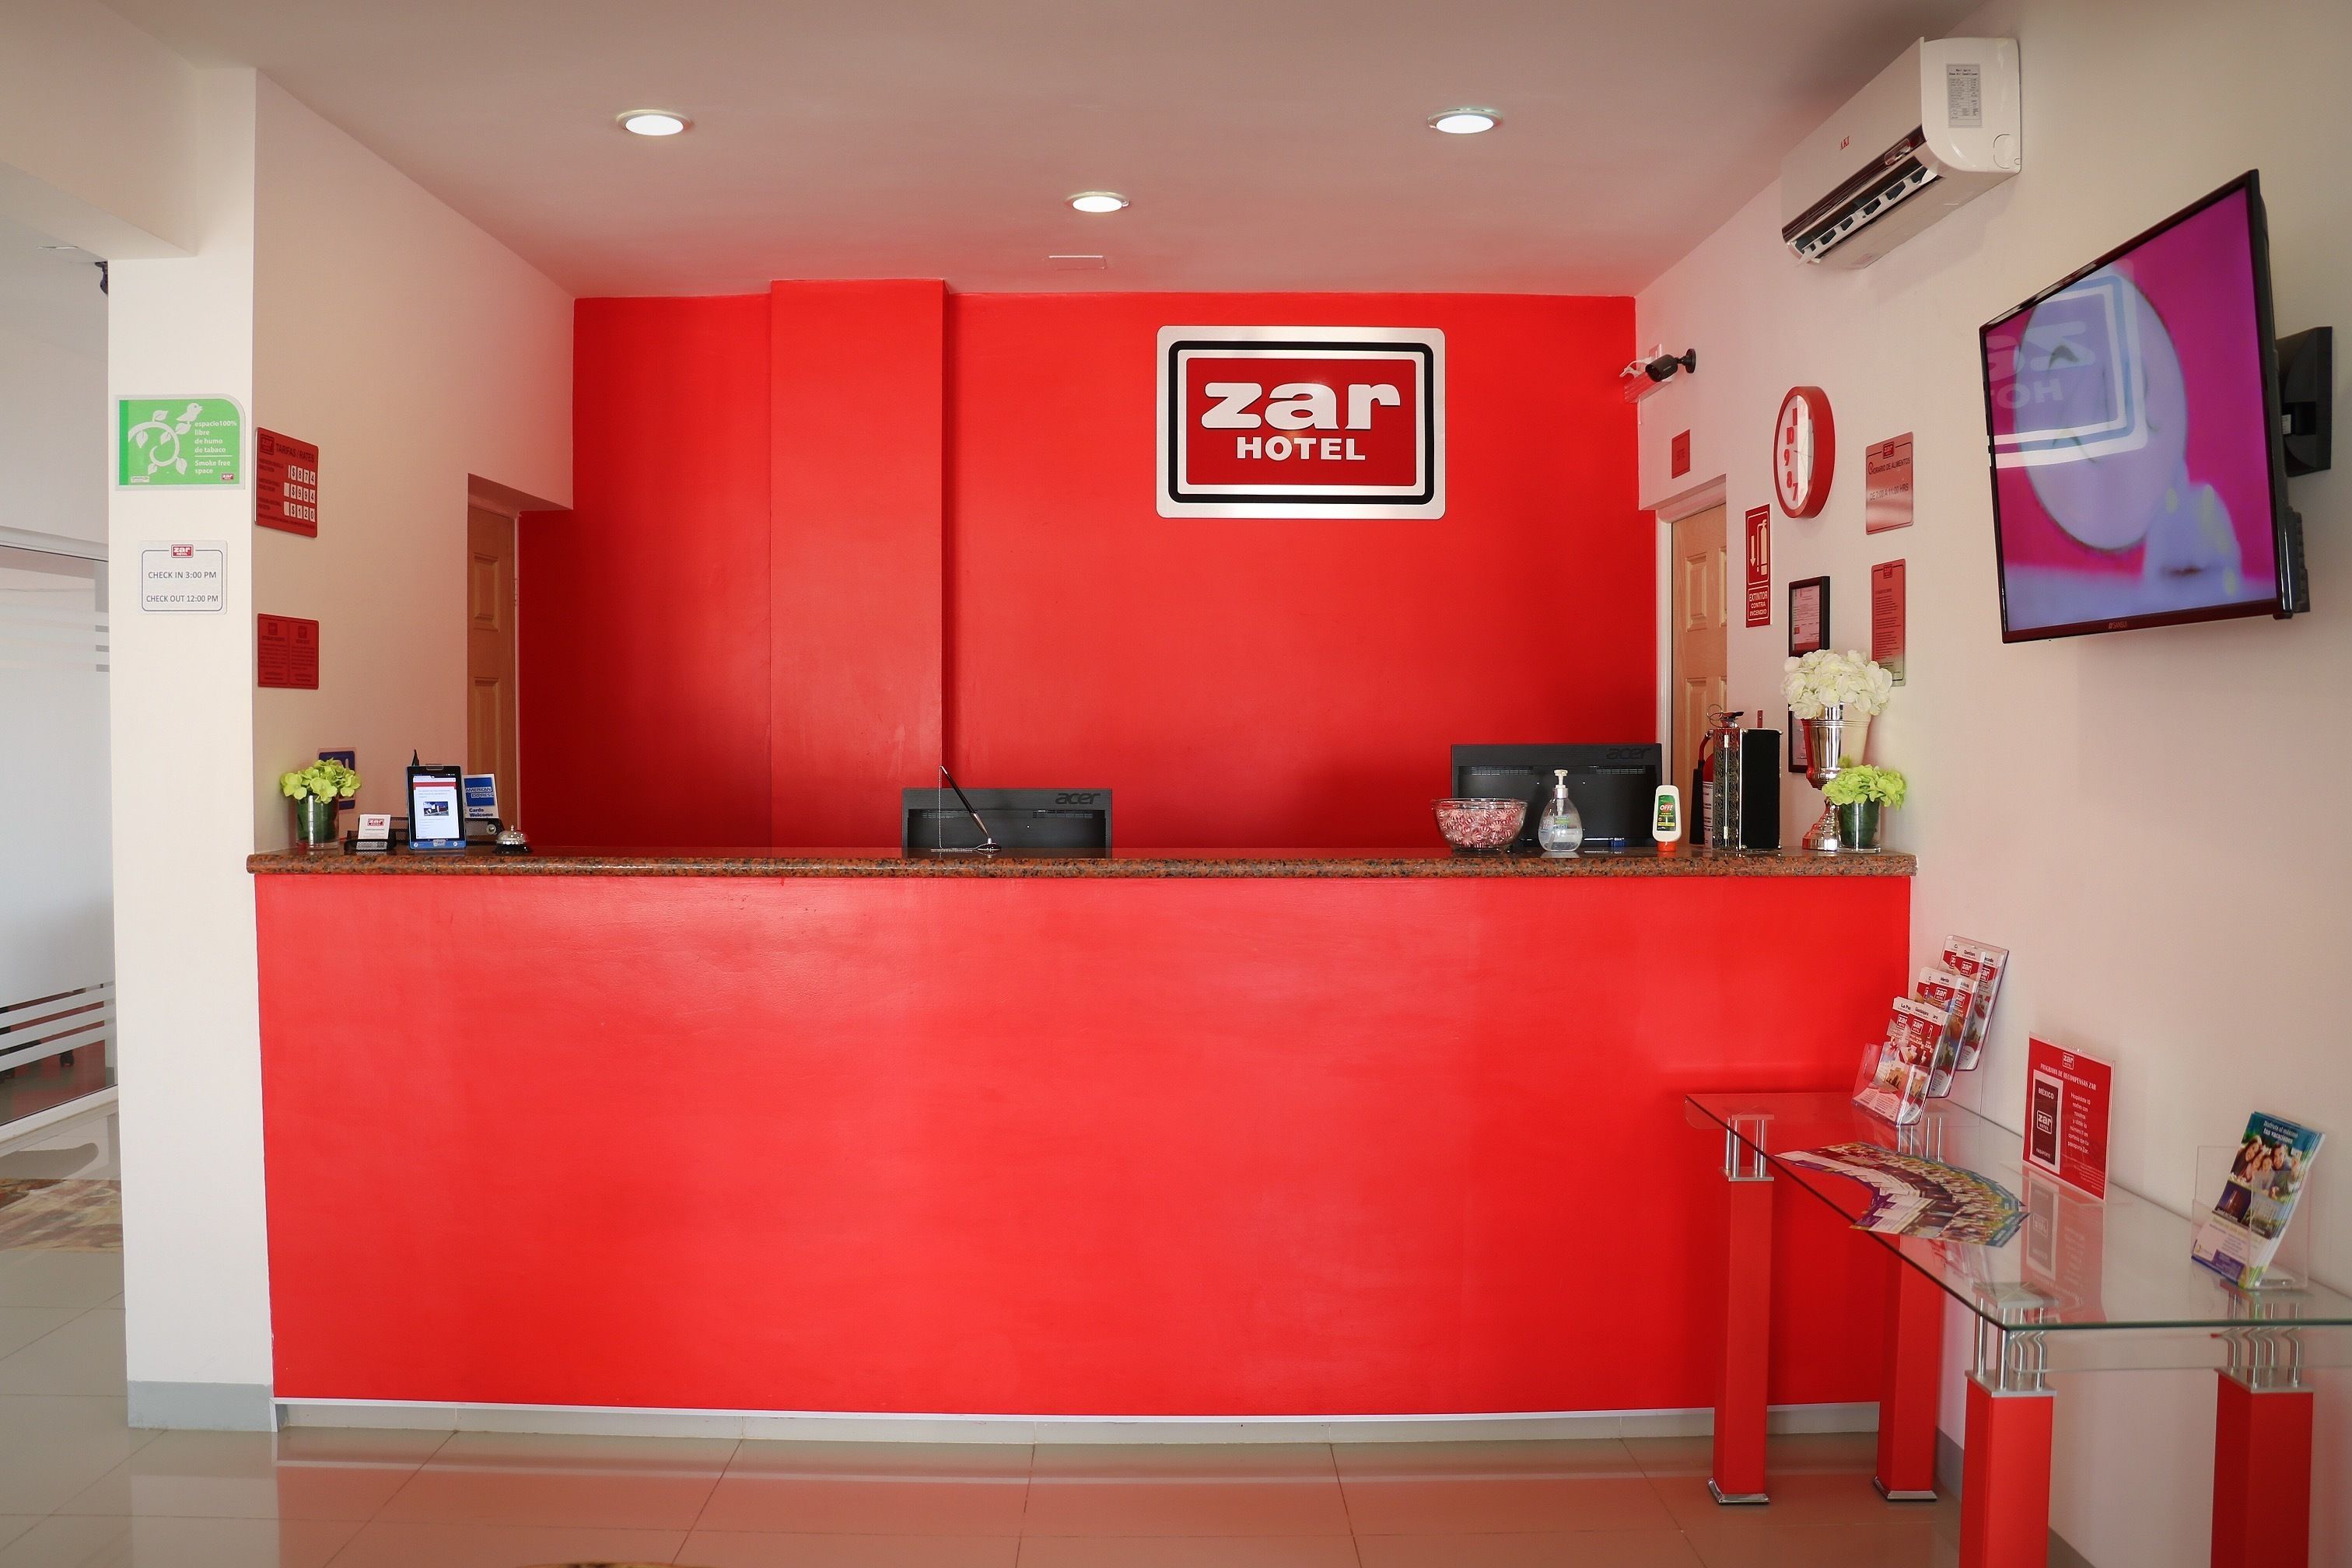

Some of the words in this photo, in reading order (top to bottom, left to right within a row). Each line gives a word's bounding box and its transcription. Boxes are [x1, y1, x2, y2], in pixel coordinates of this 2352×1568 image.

[1201, 382, 1401, 431] zar
[276, 443, 296, 457] TARIFAS
[299, 450, 315, 463] RATES
[1236, 436, 1367, 461] HOTEL
[1783, 449, 1790, 466] 9
[292, 466, 314, 482] $874
[1787, 471, 1793, 488] 8
[291, 485, 314, 500] $994
[1792, 482, 1798, 501] 7
[291, 504, 314, 519] $120
[1749, 591, 1768, 602] EXTINTOR
[1606, 747, 1652, 760] acer
[1055, 793, 1101, 805] acer
[2063, 1055, 2074, 1064] zar
[2040, 1063, 2058, 1076] PROGRAMA
[2063, 1073, 2088, 1088] RECOMPENSAS
[2038, 1113, 2053, 1125] zar
[2035, 1147, 2051, 1159] PASAPORTE
